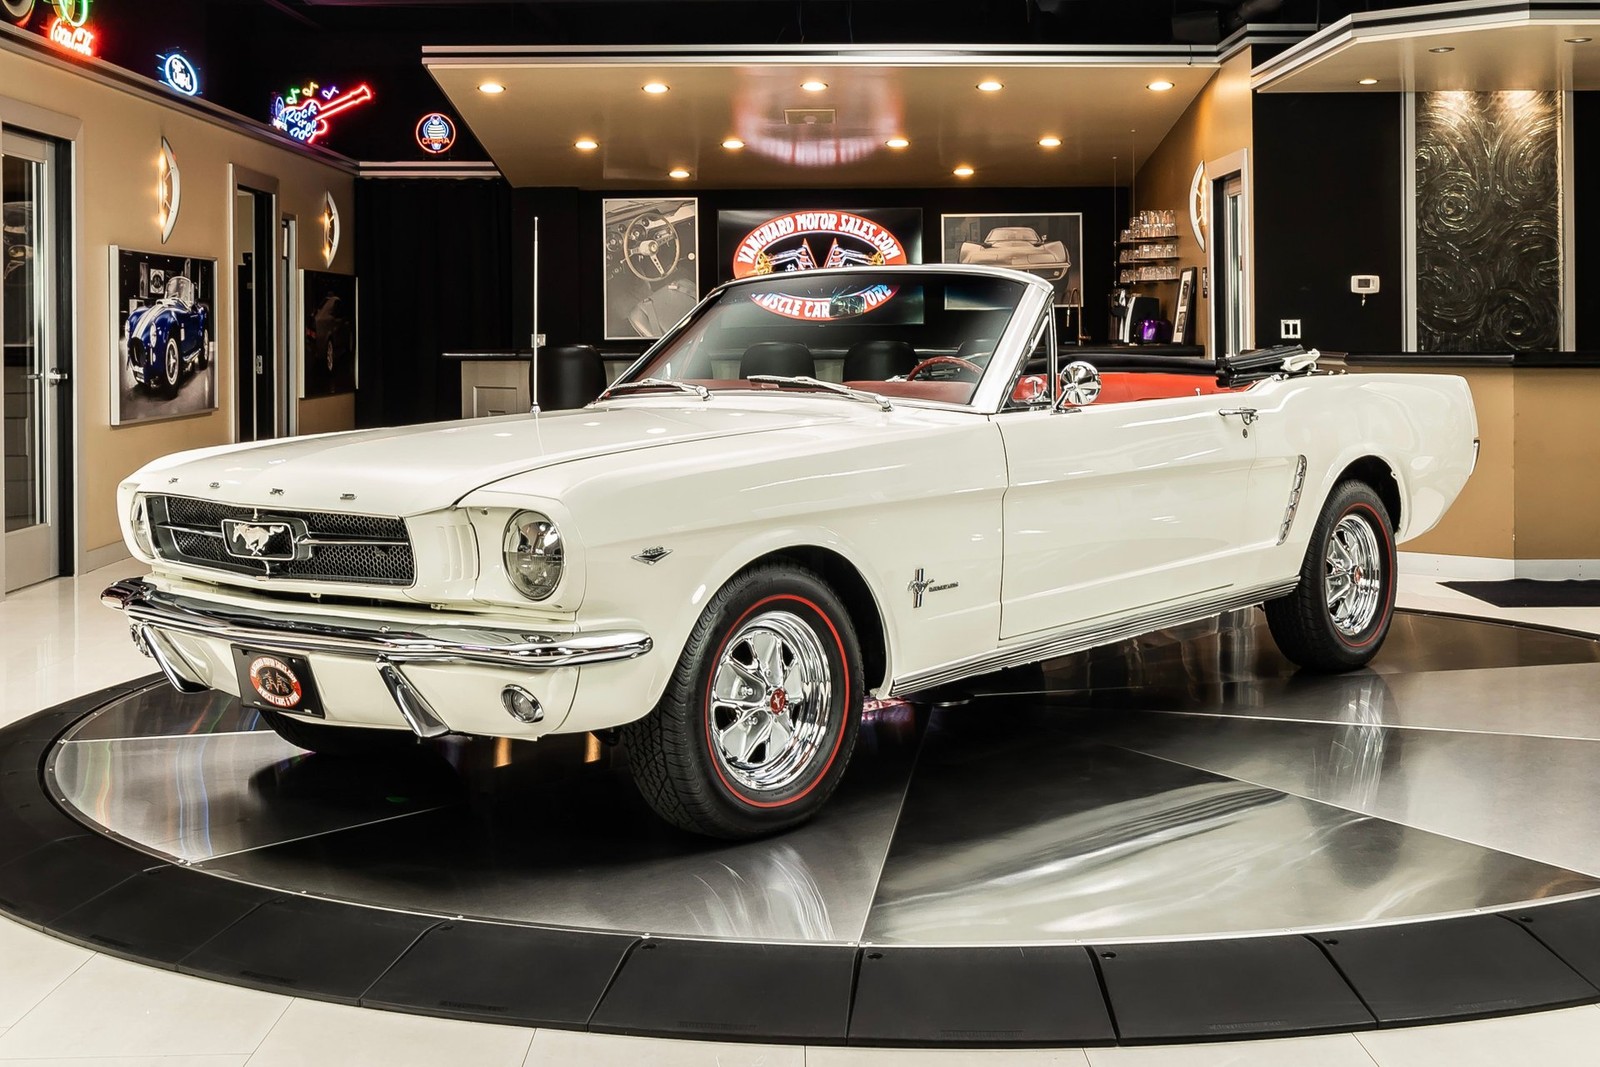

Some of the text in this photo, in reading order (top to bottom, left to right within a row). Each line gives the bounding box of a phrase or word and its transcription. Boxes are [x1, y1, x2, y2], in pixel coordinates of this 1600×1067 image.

[284, 102, 318, 124] Rock
[421, 137, 450, 145] COBRA
[737, 212, 900, 263] VANGUARD MOTOR SALES.COM
